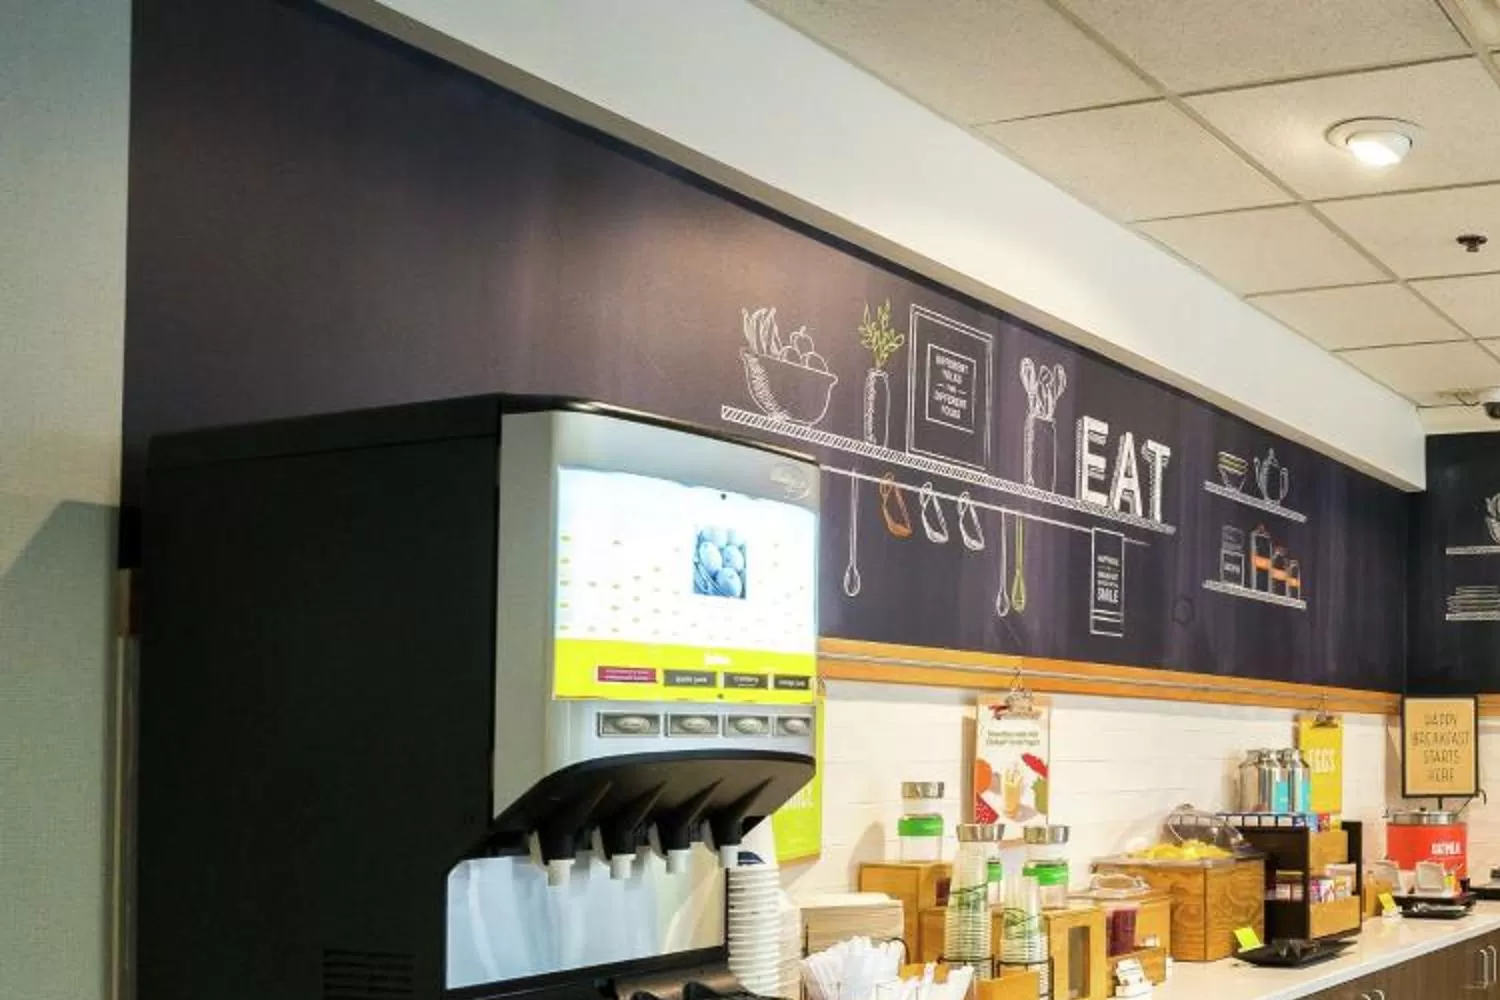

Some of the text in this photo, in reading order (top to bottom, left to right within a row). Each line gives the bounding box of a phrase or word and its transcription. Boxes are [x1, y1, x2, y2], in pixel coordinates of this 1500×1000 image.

[1075, 416, 1171, 523] EAT
[1411, 731, 1469, 746] BREAKFAST
[1423, 749, 1461, 765] STARTS
